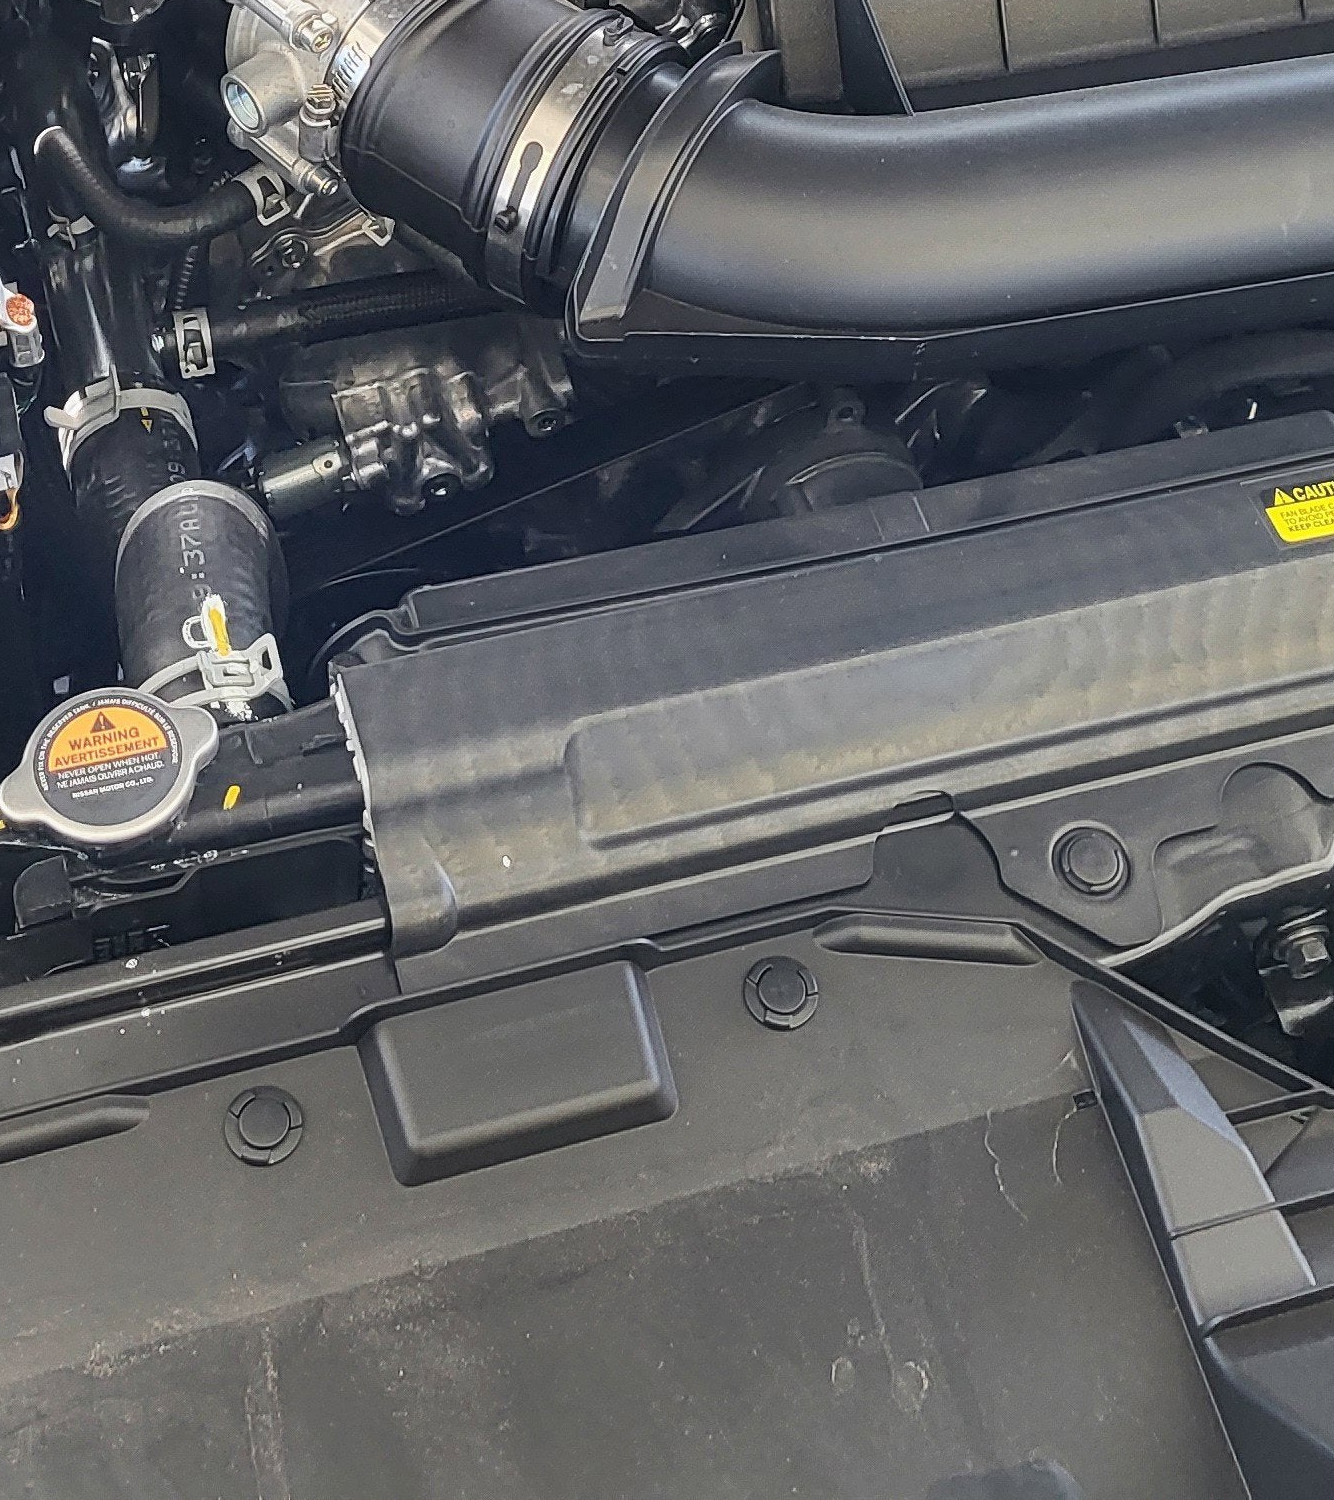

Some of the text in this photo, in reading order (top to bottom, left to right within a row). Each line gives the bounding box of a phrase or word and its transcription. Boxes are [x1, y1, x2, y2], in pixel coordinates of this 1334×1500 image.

[1280, 510, 1297, 519] FAN
[1298, 505, 1326, 516] BLADE
[1284, 518, 1297, 526] TO
[1298, 512, 1323, 523] AVOID
[1288, 522, 1312, 532] KEEP
[69, 727, 139, 751] WARNING
[55, 737, 159, 768] AVERTISSEMENT
[58, 767, 86, 780] NEVER
[87, 762, 111, 774] OPEN
[113, 756, 141, 768] WHEN
[57, 780, 68, 789] NE
[69, 774, 97, 788] JAMAIS
